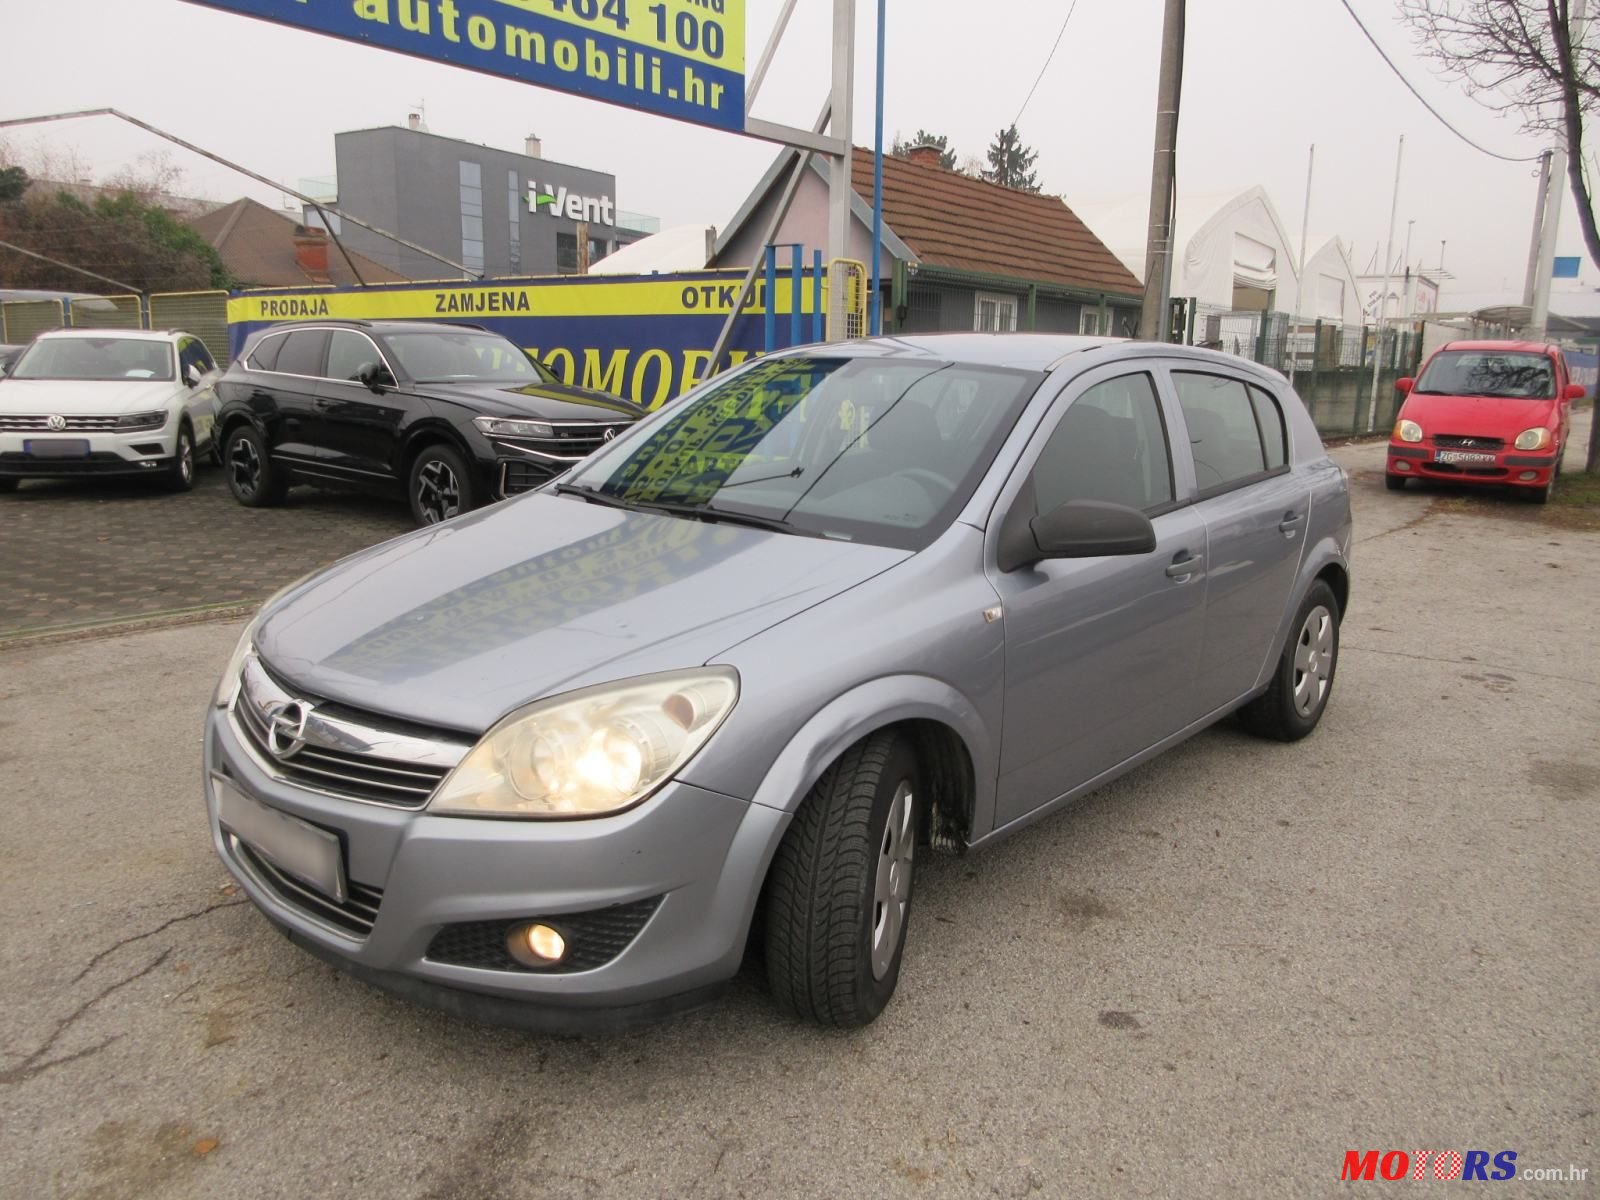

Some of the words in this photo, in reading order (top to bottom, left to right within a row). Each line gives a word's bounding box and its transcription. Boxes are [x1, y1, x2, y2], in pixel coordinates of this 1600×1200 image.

[649, 4, 724, 60] 100
[260, 299, 329, 317] PRODAJA
[435, 291, 531, 313] ZAMJENA
